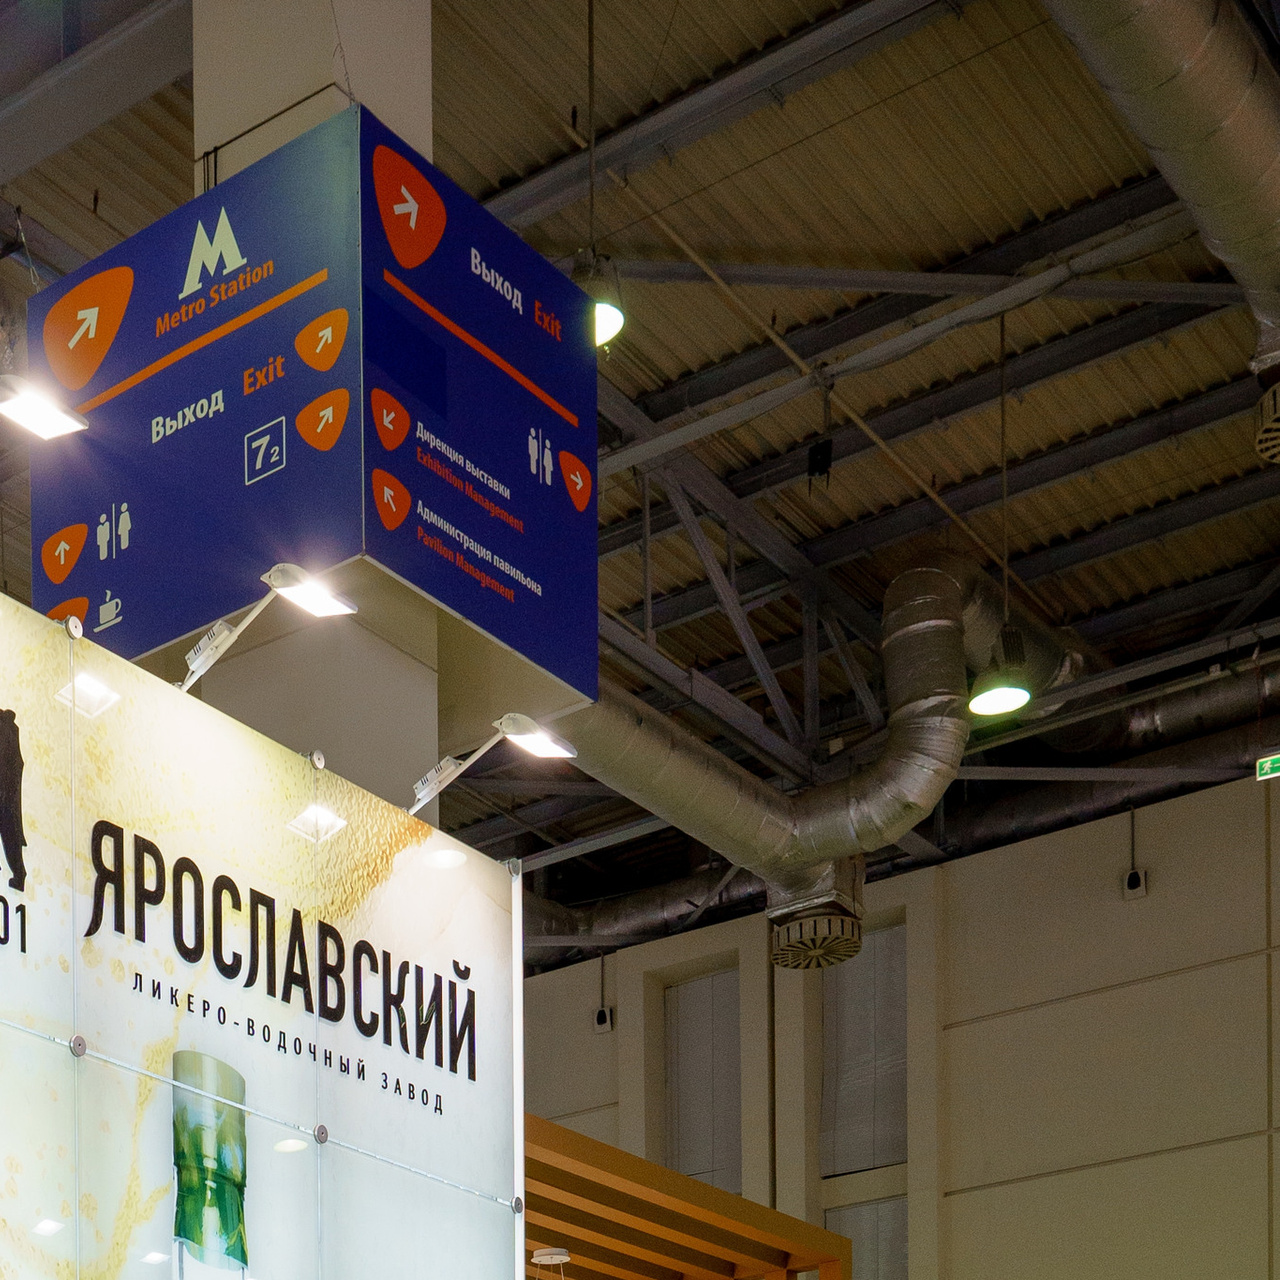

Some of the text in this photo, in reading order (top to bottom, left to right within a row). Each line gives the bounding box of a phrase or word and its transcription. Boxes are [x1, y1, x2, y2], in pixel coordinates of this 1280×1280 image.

[155, 259, 275, 338] Metro Station
[471, 247, 523, 315] Выход
[534, 300, 562, 342] Exit
[243, 355, 285, 396] Exit
[151, 389, 225, 444] Выход
[416, 421, 510, 500] Дирекция выставки
[416, 446, 524, 534] Exhibition Management
[416, 500, 542, 597] Администрация павильона
[417, 526, 515, 603] Pavilion Management
[83, 819, 476, 1082] ЯРОСЛАВСКИЙ
[132, 972, 443, 1115] ЛИКЕРО-ВОДОЧНЫЙ ЗАВОД
